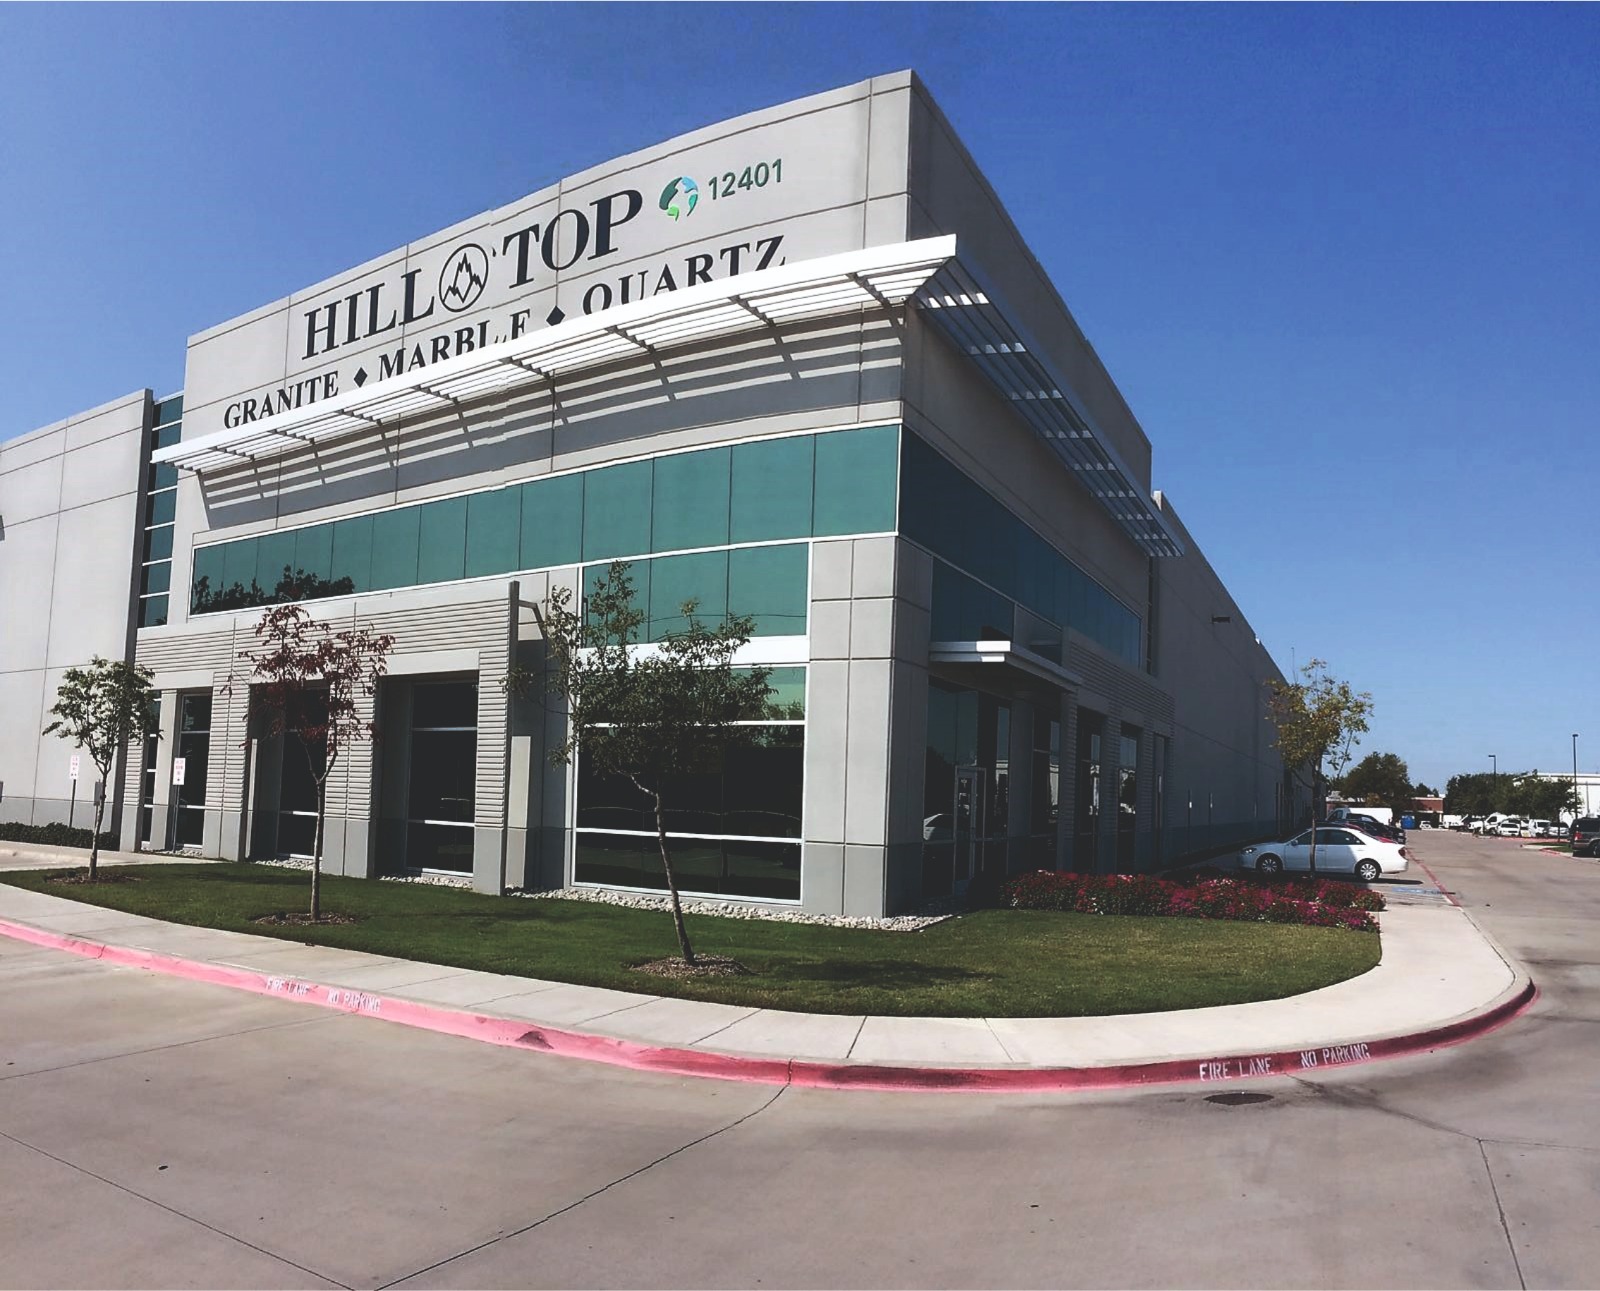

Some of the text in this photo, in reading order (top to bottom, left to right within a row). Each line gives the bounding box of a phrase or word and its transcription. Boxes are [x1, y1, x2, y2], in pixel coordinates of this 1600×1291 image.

[708, 158, 782, 200] 12401
[302, 189, 643, 360] HILL TOP
[224, 370, 339, 430] GRANITE
[582, 235, 786, 315] QUARTZ
[328, 988, 340, 1004] NO
[343, 992, 381, 1012] PARKING
[1199, 1043, 1371, 1082] FIRE LANE NO PARKING
